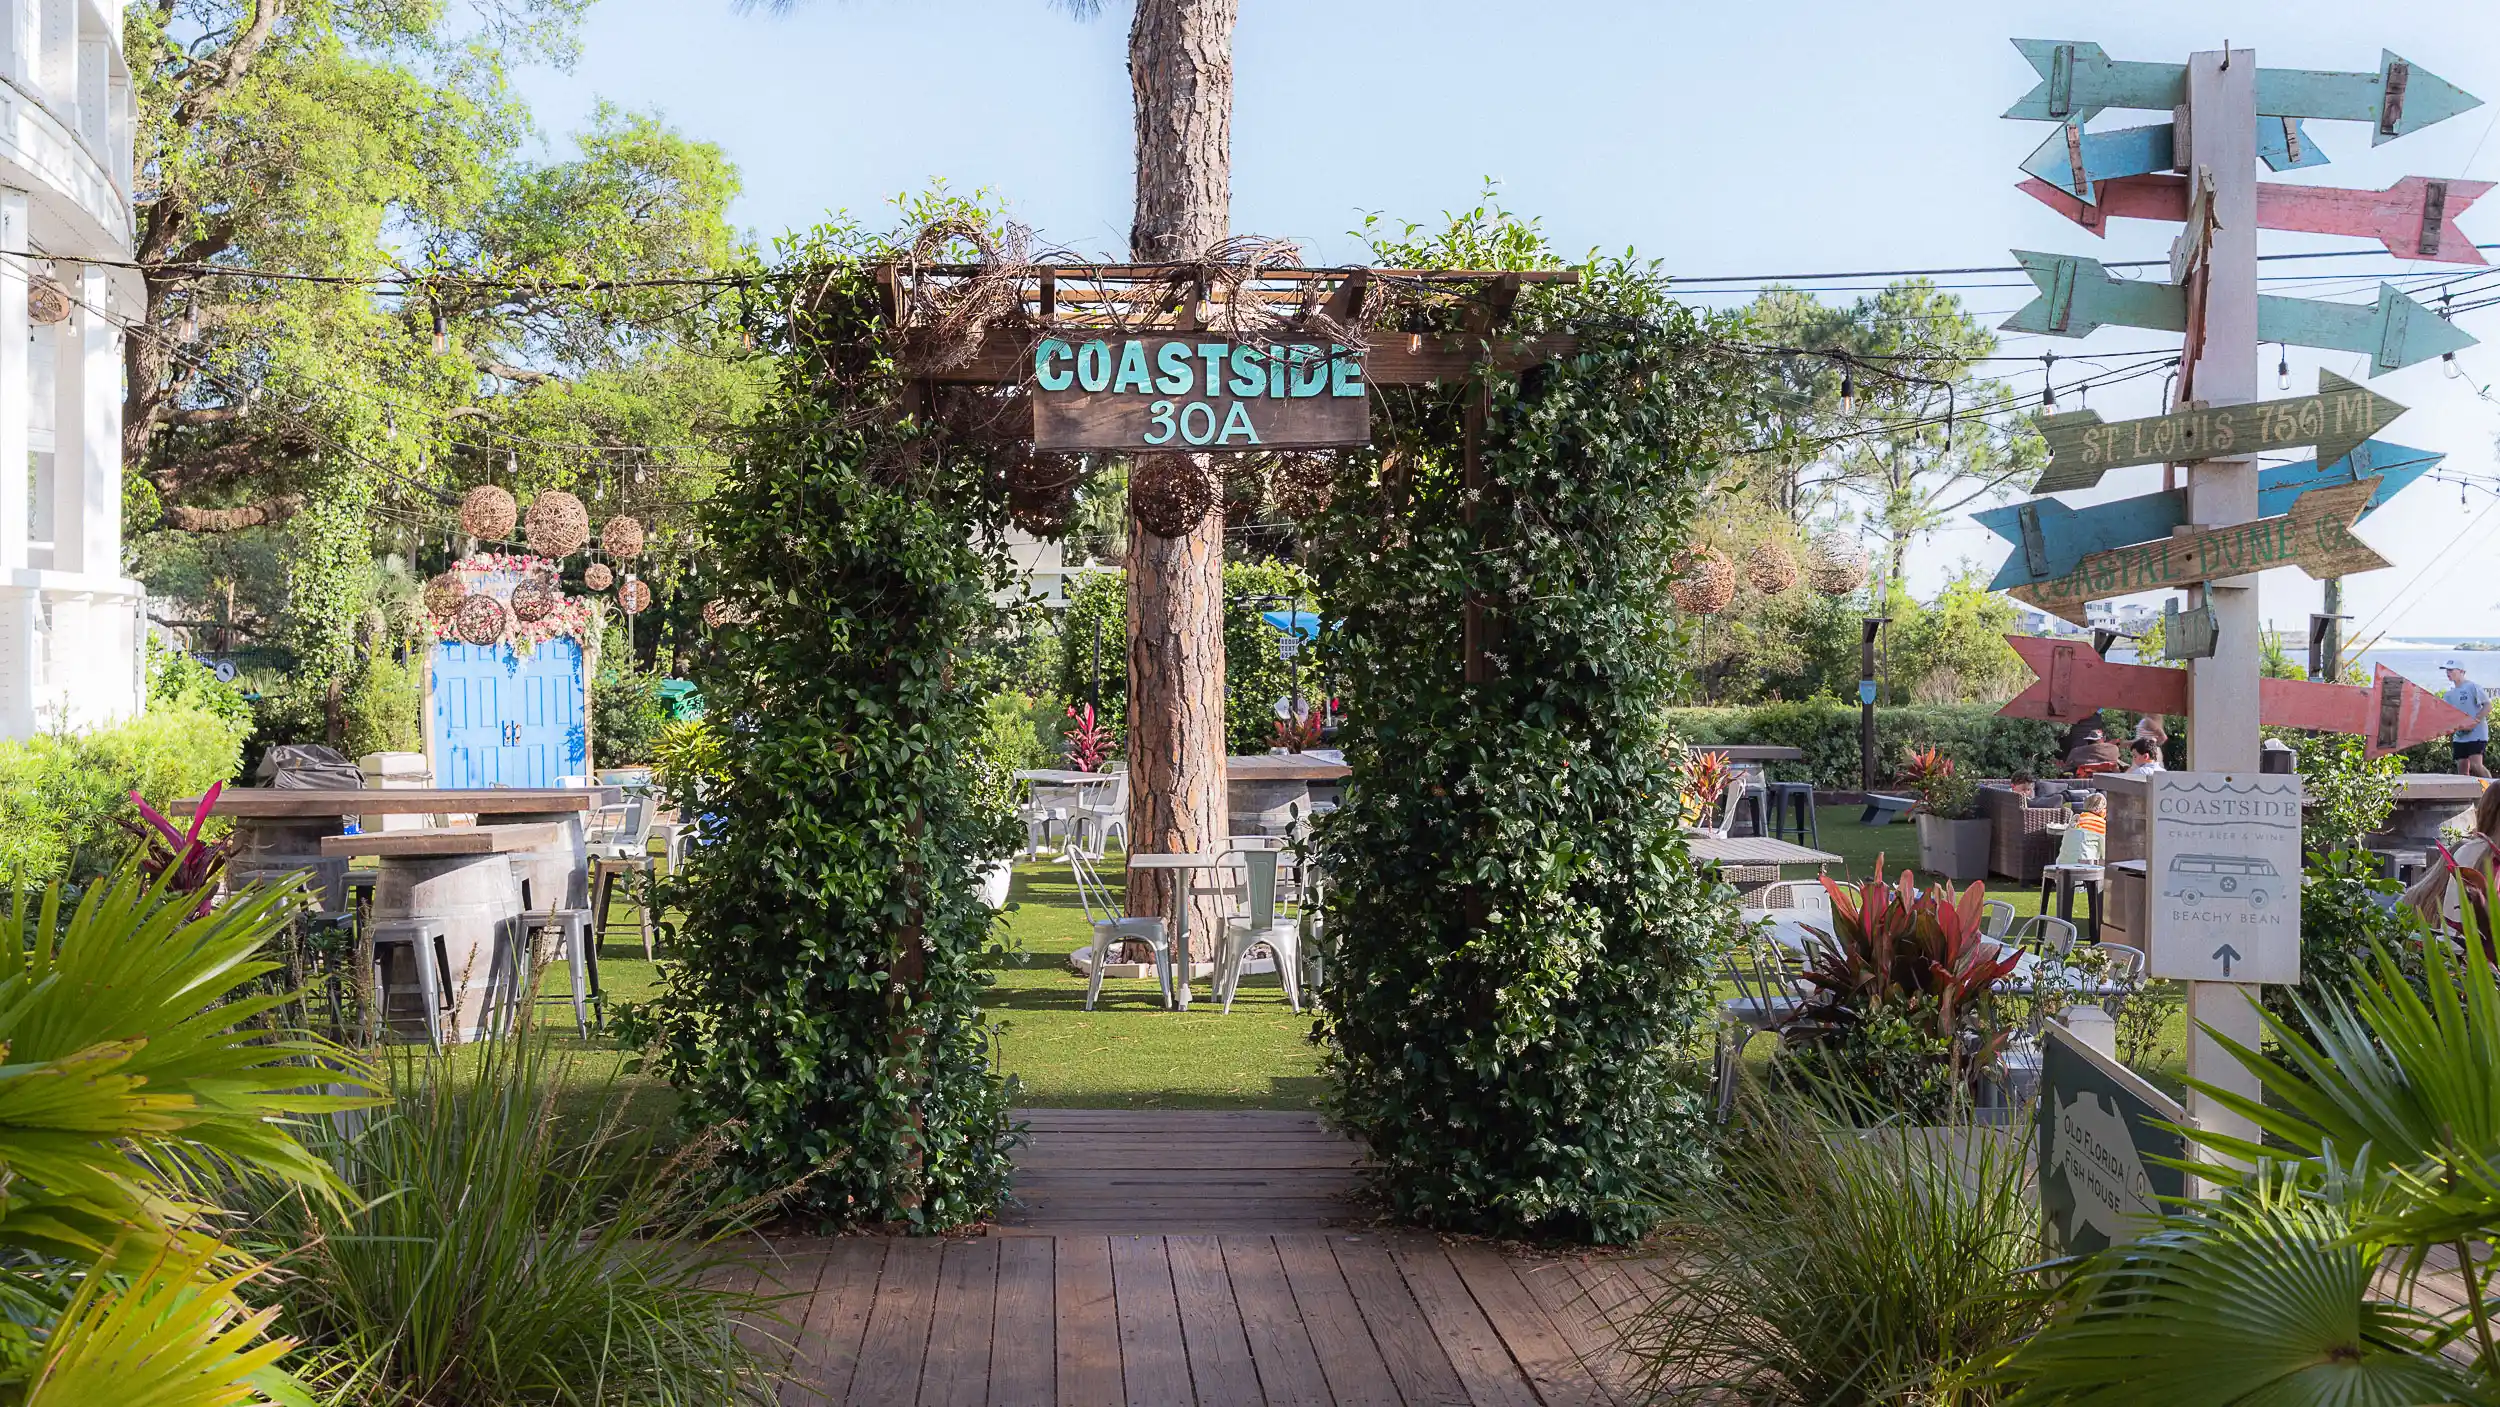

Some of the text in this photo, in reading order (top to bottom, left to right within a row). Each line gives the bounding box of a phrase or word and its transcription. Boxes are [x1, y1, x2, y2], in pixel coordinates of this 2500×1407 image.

[1035, 339, 1366, 398] COASTSIDE
[1144, 400, 1262, 446] 30A
[2082, 426, 2121, 464] ST.
[2133, 412, 2235, 459] LOUIS
[2199, 519, 2299, 574] DUNE
[2160, 798, 2296, 817] COASTSIDE
[2168, 830, 2203, 839] CRAFT
[2254, 832, 2285, 841] WINE
[2173, 910, 2281, 925] BEACHY BEAN
[2064, 1115, 2124, 1182] OLD FLORIDA
[2065, 1150, 2121, 1215] FISH HOUSE
